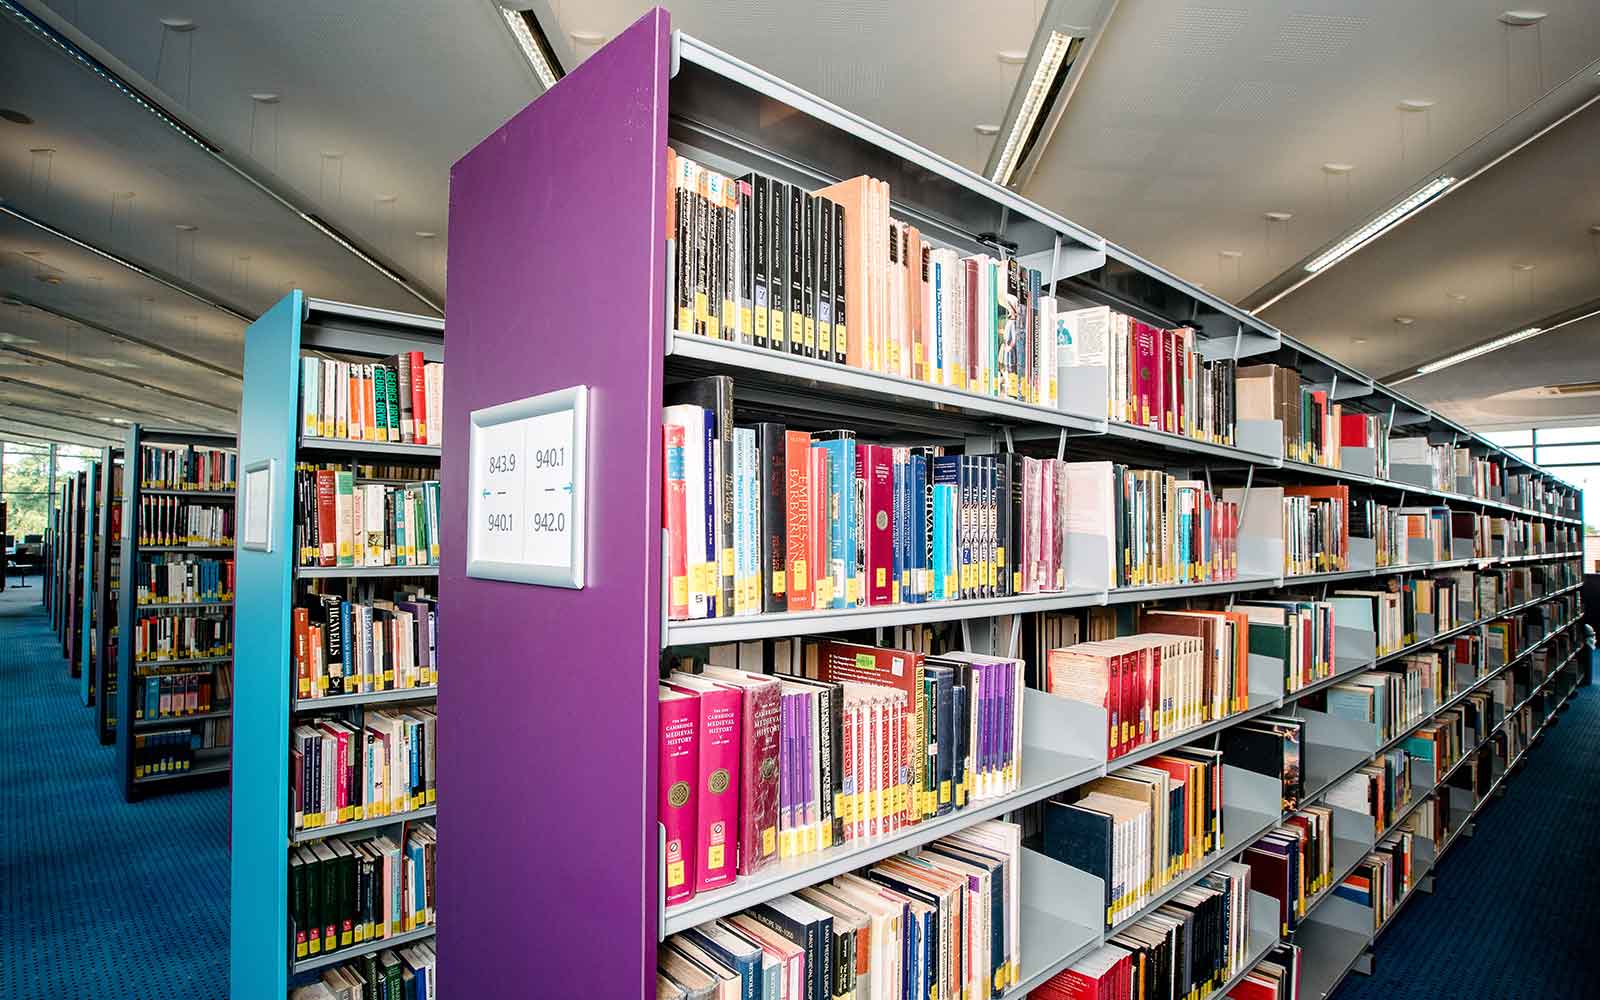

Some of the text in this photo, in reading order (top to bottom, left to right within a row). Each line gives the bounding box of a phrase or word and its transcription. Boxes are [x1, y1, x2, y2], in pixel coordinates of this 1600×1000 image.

[376, 369, 386, 428] GEORGE ORWE
[387, 372, 398, 428] GEORGE ORWE
[489, 454, 516, 474] 843.9
[536, 447, 565, 468] 940.1
[799, 474, 808, 540] EMPIRES
[488, 512, 513, 532] 940.1
[534, 512, 565, 532] 942.0
[665, 729, 694, 738] MEDIEVAL
[668, 736, 692, 746] HISTORY
